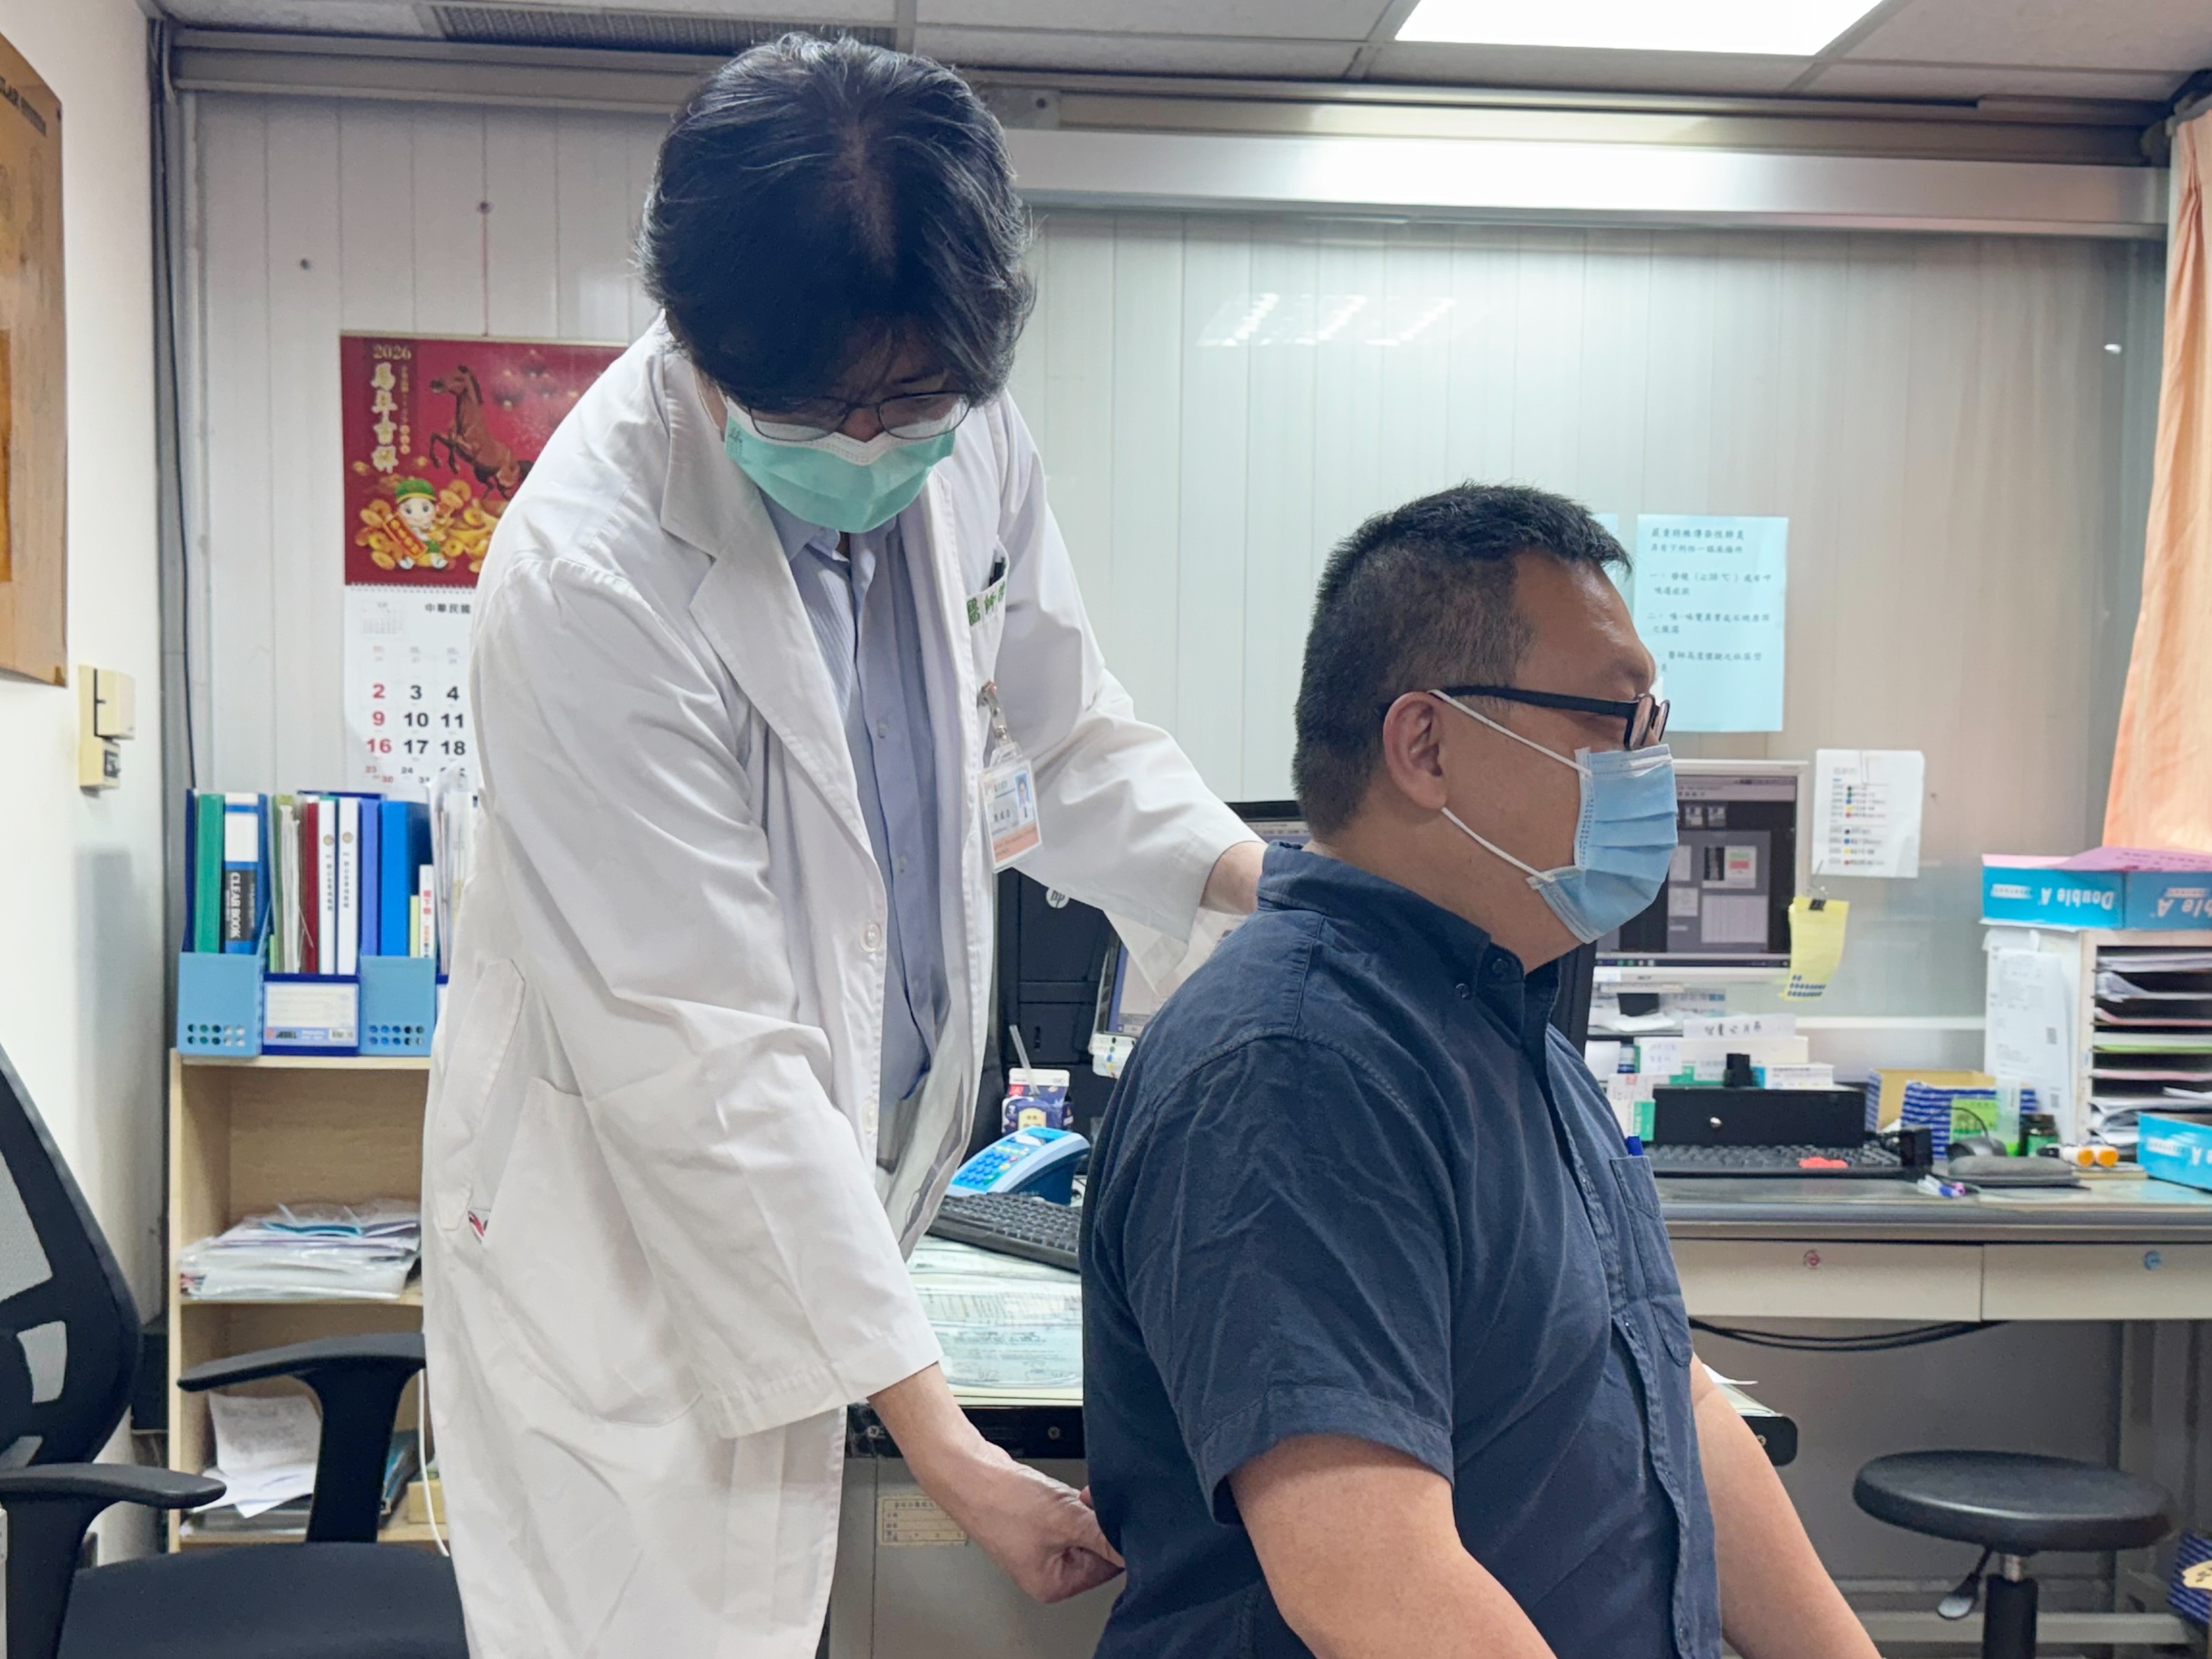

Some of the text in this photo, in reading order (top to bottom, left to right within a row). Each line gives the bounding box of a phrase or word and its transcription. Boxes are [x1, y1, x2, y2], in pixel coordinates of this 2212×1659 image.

[373, 345, 411, 359] 2026
[425, 603, 471, 614] 中華民國
[372, 683, 459, 701] 2 3 4
[373, 711, 464, 728] 9 10 11
[366, 739, 466, 756] 16 17 18
[231, 872, 240, 938] CLEAR BOOK
[2041, 888, 2052, 905] A
[2057, 888, 2114, 910] Double
[2157, 898, 2172, 918] A
